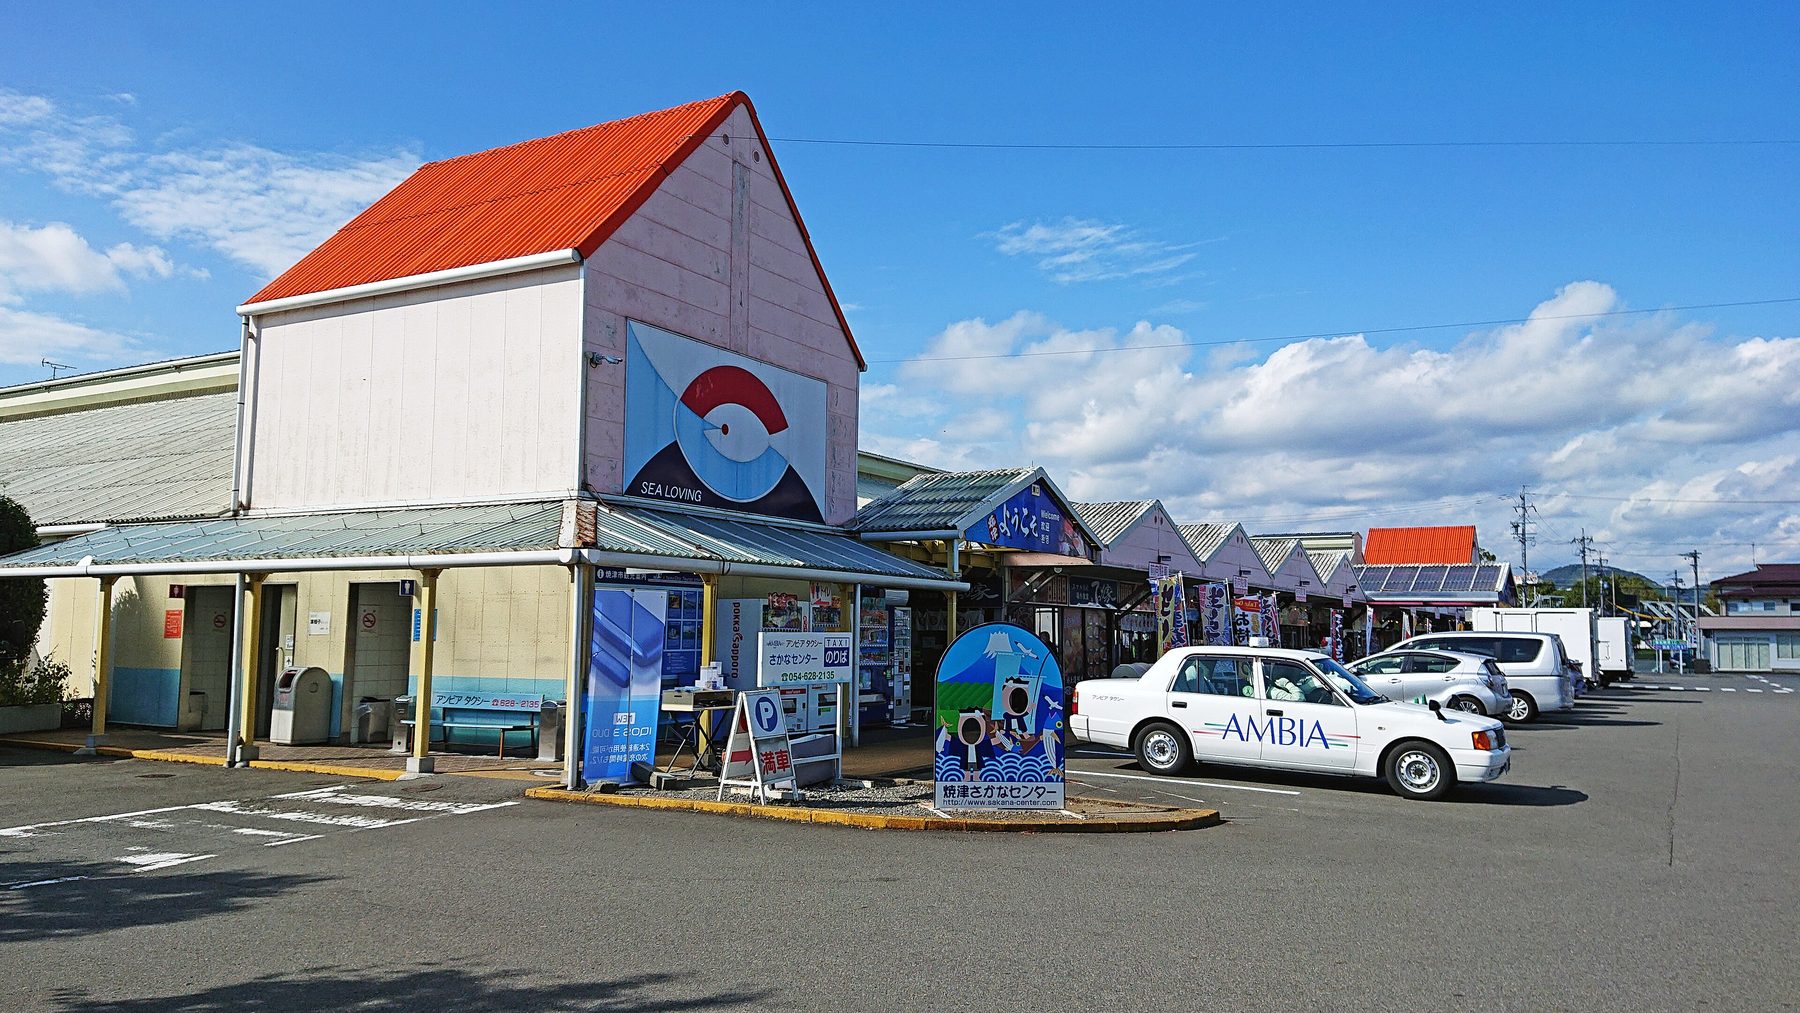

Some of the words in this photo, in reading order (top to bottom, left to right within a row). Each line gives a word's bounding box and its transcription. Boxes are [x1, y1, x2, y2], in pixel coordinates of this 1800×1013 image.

[641, 481, 663, 497] SEA
[664, 485, 702, 502] LOVING
[999, 503, 1039, 538] ようこそ
[1040, 509, 1060, 522] Welcome
[827, 639, 848, 647] TAXI
[769, 653, 818, 666] さかなセンター
[825, 650, 848, 664] のりば
[788, 671, 835, 681] 054-628-2135
[436, 694, 463, 705] アンビア
[464, 696, 491, 706] タクシー
[759, 701, 774, 729] P
[1222, 712, 1330, 750] AMBIA
[760, 749, 791, 775] 満車
[943, 784, 1057, 799] 焼津さかなセンター
[943, 799, 1058, 807] http://www.sakana-center.com
